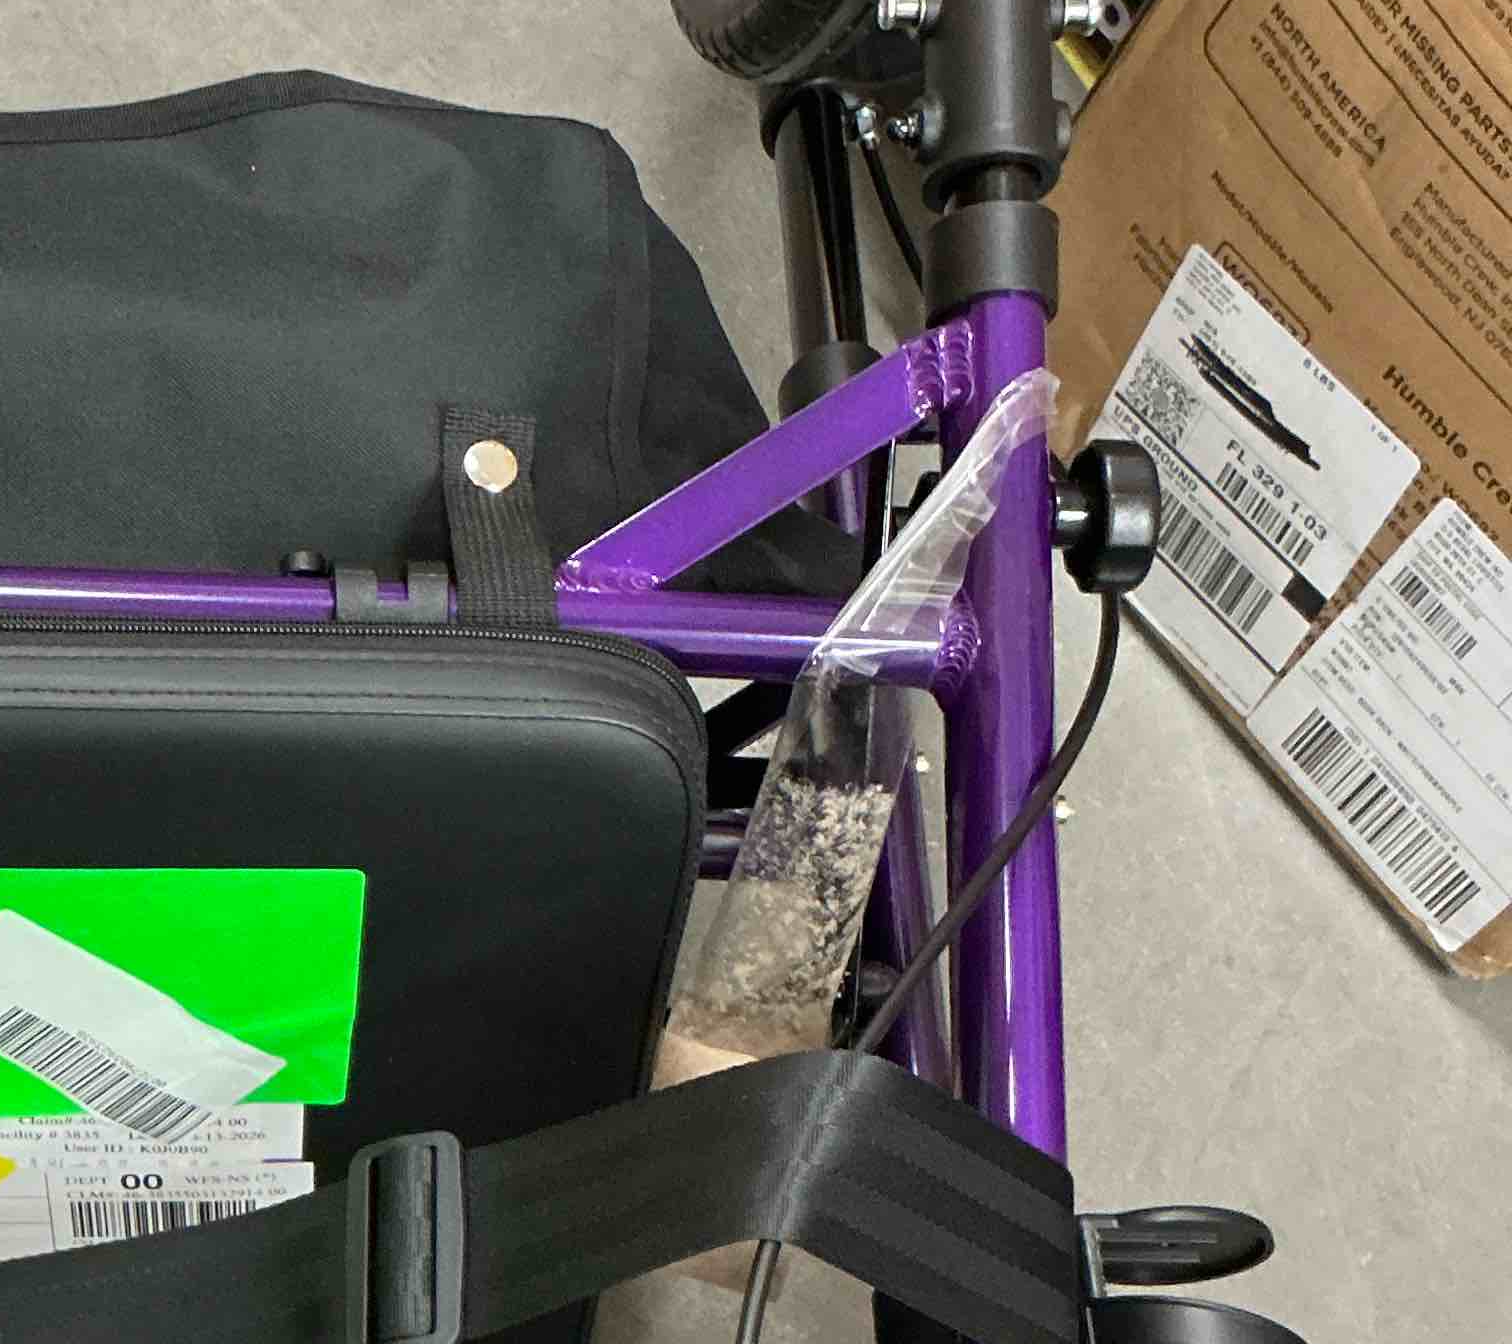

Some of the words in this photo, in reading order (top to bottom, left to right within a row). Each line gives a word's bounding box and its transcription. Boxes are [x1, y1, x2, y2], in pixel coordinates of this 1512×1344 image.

[1270, 2, 1321, 72] NORTH
[1318, 70, 1387, 156] AMERICA
[1400, 15, 1461, 95] MISSING
[1459, 90, 1512, 164] PARTS
[1113, 406, 1141, 435] UPS
[1141, 434, 1199, 494] GROUND
[1225, 438, 1246, 466] FL
[1251, 463, 1286, 499] 329
[1290, 500, 1329, 543] 1-03
[1382, 363, 1468, 459] Humble
[1471, 460, 1512, 517] Cre
[120, 1174, 164, 1190] 00
